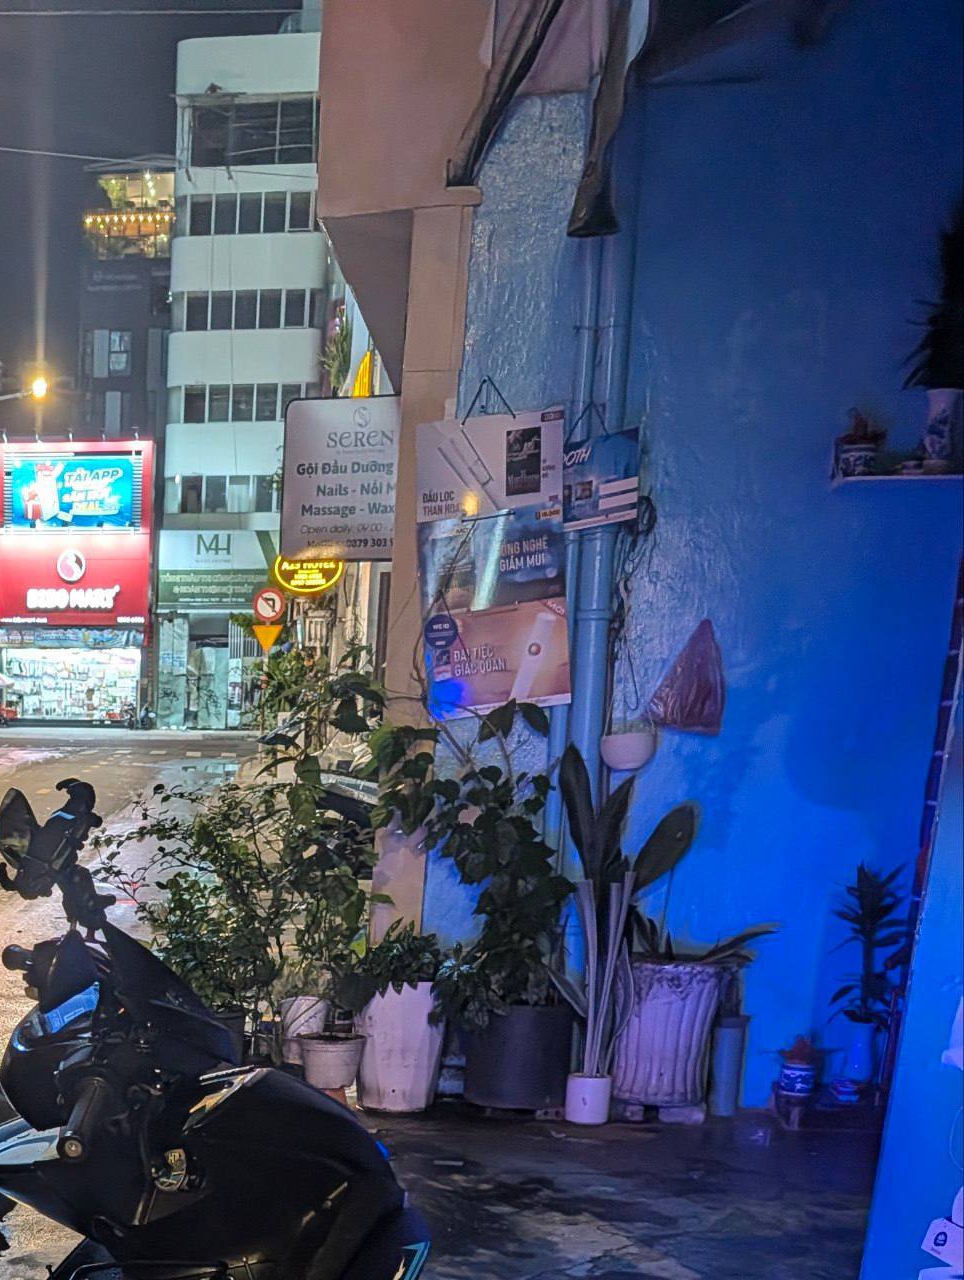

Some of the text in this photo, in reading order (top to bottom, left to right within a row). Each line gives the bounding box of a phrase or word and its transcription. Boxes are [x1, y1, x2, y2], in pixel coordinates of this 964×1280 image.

[296, 459, 394, 478] Gội Đầu Dưỡng
[91, 470, 120, 481] APP
[316, 484, 349, 496] Nails
[301, 503, 356, 518] Massage
[300, 524, 328, 535] Open
